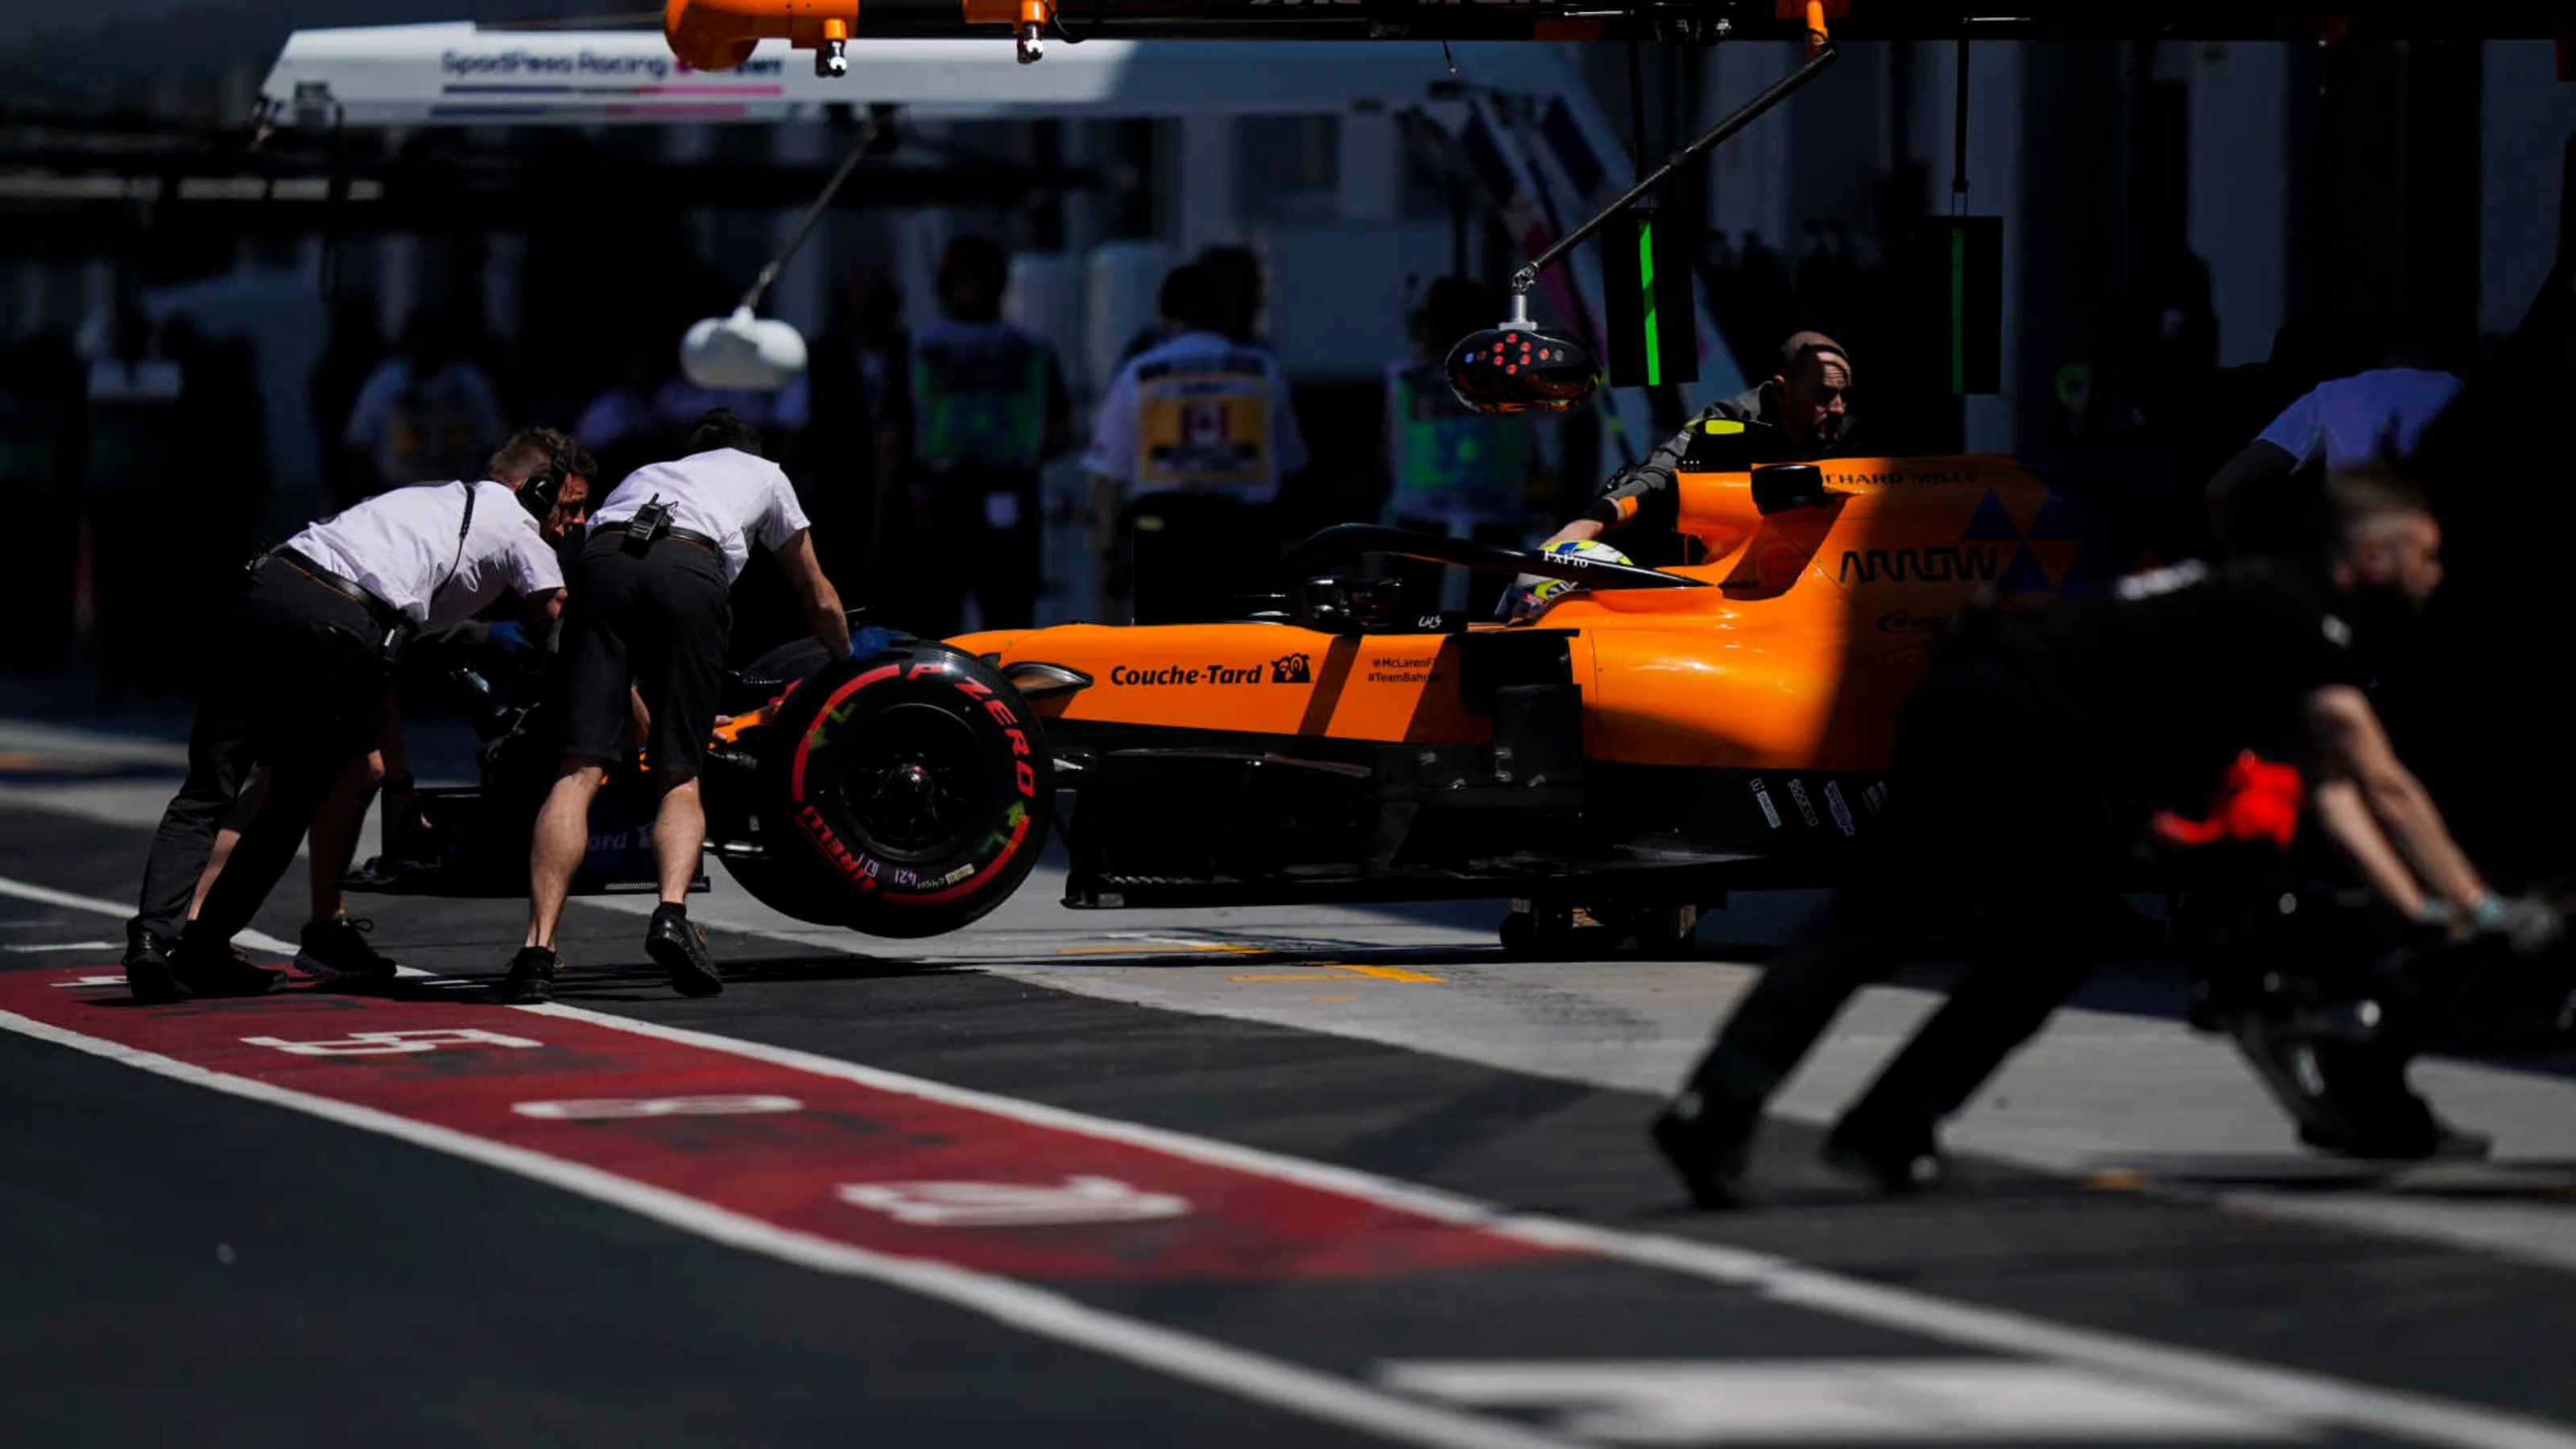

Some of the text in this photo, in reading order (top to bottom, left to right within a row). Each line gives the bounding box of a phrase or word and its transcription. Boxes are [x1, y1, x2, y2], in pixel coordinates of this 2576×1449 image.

[577, 50, 668, 80] Racing
[1822, 473, 1903, 484] CHARD
[1841, 545, 1998, 582] ARROW
[1110, 664, 1263, 685] Couche-Tard
[953, 675, 1036, 799] ZERO
